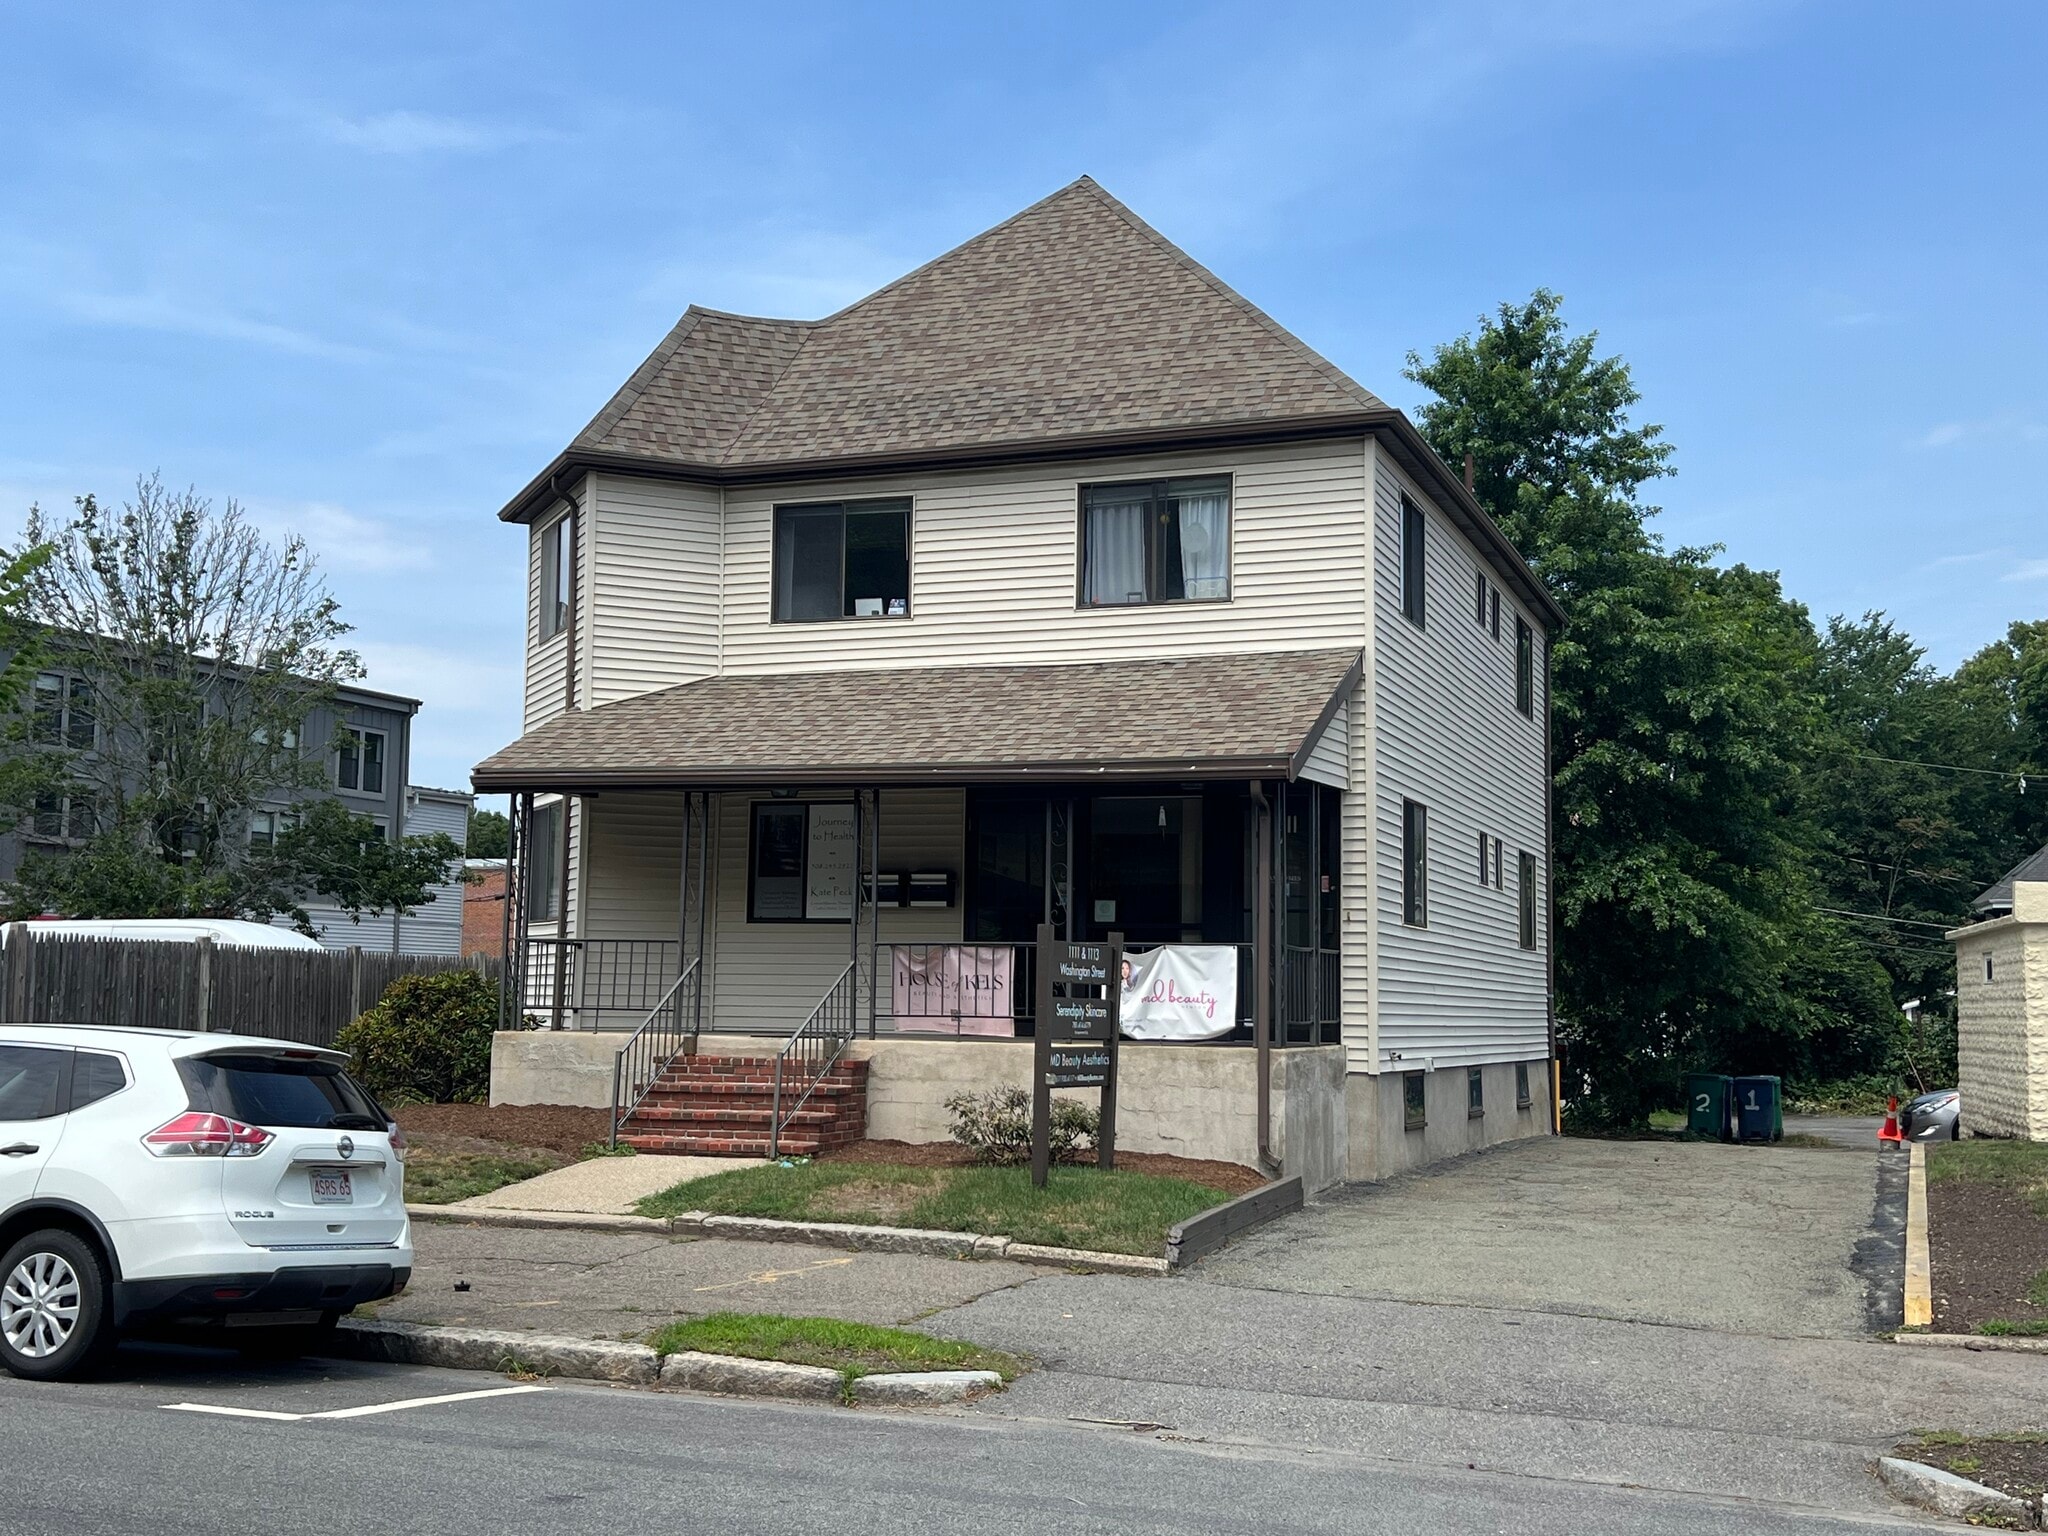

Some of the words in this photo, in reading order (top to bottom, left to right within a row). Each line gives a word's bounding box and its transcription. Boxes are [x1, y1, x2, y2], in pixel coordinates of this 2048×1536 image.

[814, 815, 854, 829] Journey
[824, 831, 854, 841] Health
[811, 886, 831, 897] Kate
[833, 886, 853, 897] Peck
[1068, 946, 1080, 959] 1111
[1081, 947, 1087, 959] &
[1088, 948, 1100, 961] 1113
[1060, 962, 1091, 980] Washington
[1091, 965, 1106, 978] Street
[899, 971, 950, 989] HOUSE
[1141, 979, 1166, 1003] md
[1168, 979, 1218, 1018] beauty
[1056, 1002, 1085, 1020] Serendipity
[1085, 1003, 1107, 1017] Skincare
[1050, 1053, 1061, 1066] MD
[1062, 1053, 1081, 1070] Beauty
[1082, 1051, 1110, 1066] Aesthetics
[1745, 1089, 1760, 1111] 1
[315, 1180, 337, 1195] 4SRS
[340, 1180, 351, 1195] 65
[234, 1210, 274, 1218] ROGUE
